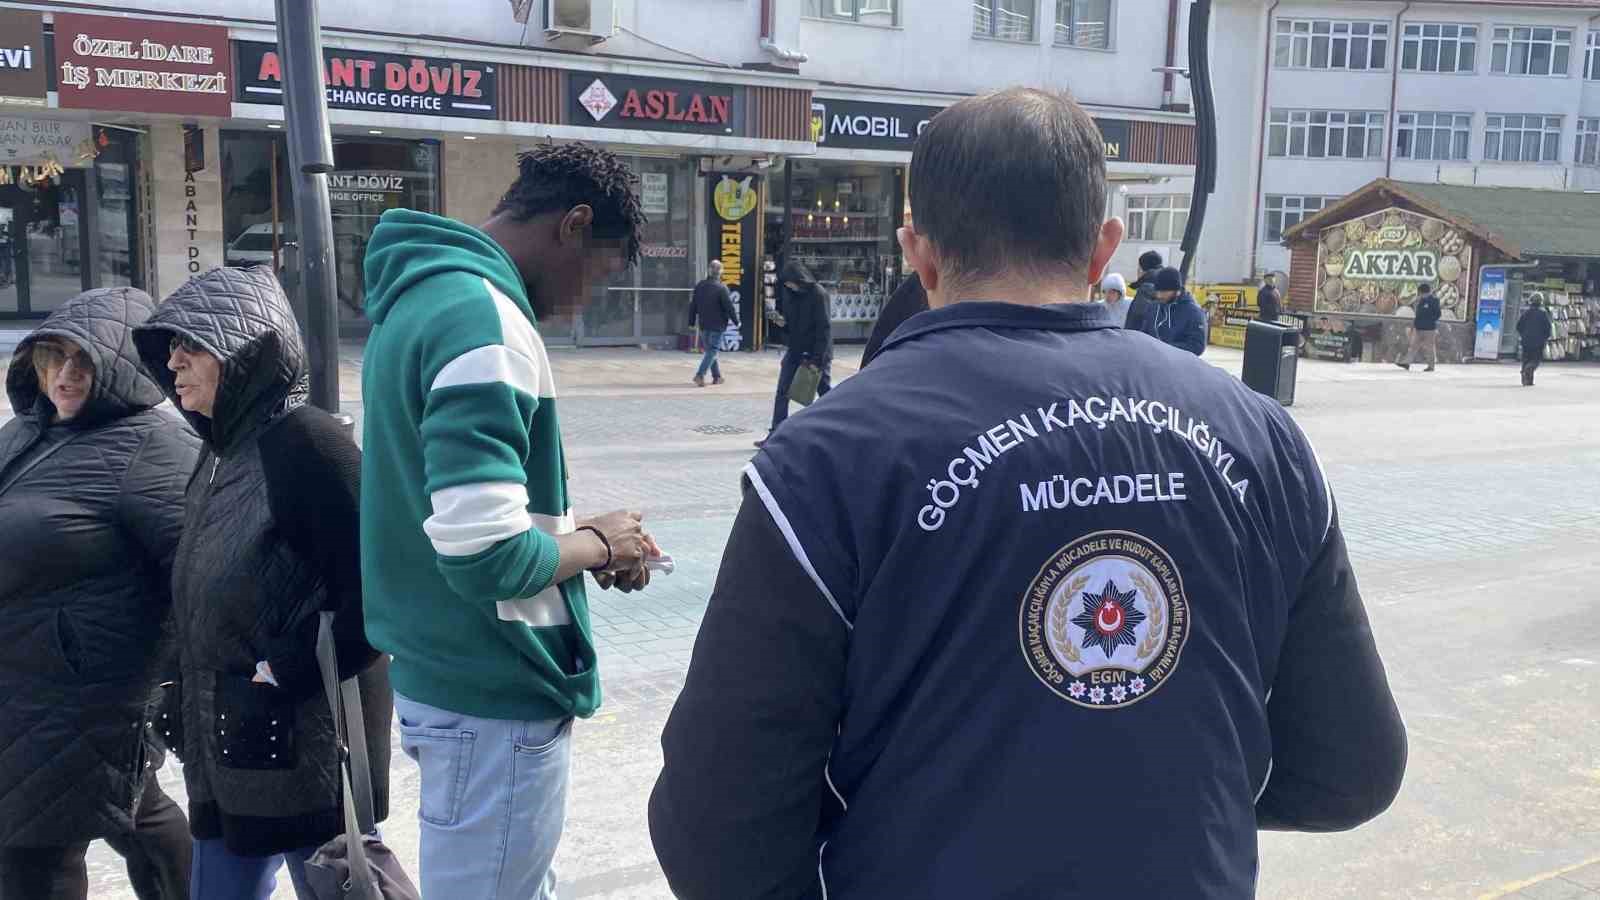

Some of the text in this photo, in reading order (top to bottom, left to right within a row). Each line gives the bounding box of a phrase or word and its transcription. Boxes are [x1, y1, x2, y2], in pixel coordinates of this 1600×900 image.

[72, 33, 214, 65] ÖZEL İDARE
[61, 61, 227, 94] İŞ MERKEZİ
[258, 51, 483, 98] ANT DÖVİZ
[325, 89, 387, 106] CHANGE
[619, 88, 732, 124] ASLAN
[326, 174, 354, 188] ANT
[184, 171, 198, 241] ABANT
[1346, 253, 1434, 277] AKTAR
[917, 396, 1250, 531] GÖÇMEN KAÇAKÇILIĞIYLA
[1019, 472, 1187, 512] MÜCADELE
[1055, 538, 1108, 571] MÜCADELE
[1108, 538, 1122, 550] VE
[1122, 540, 1153, 561] HUDUT
[1091, 670, 1127, 684] EGM
